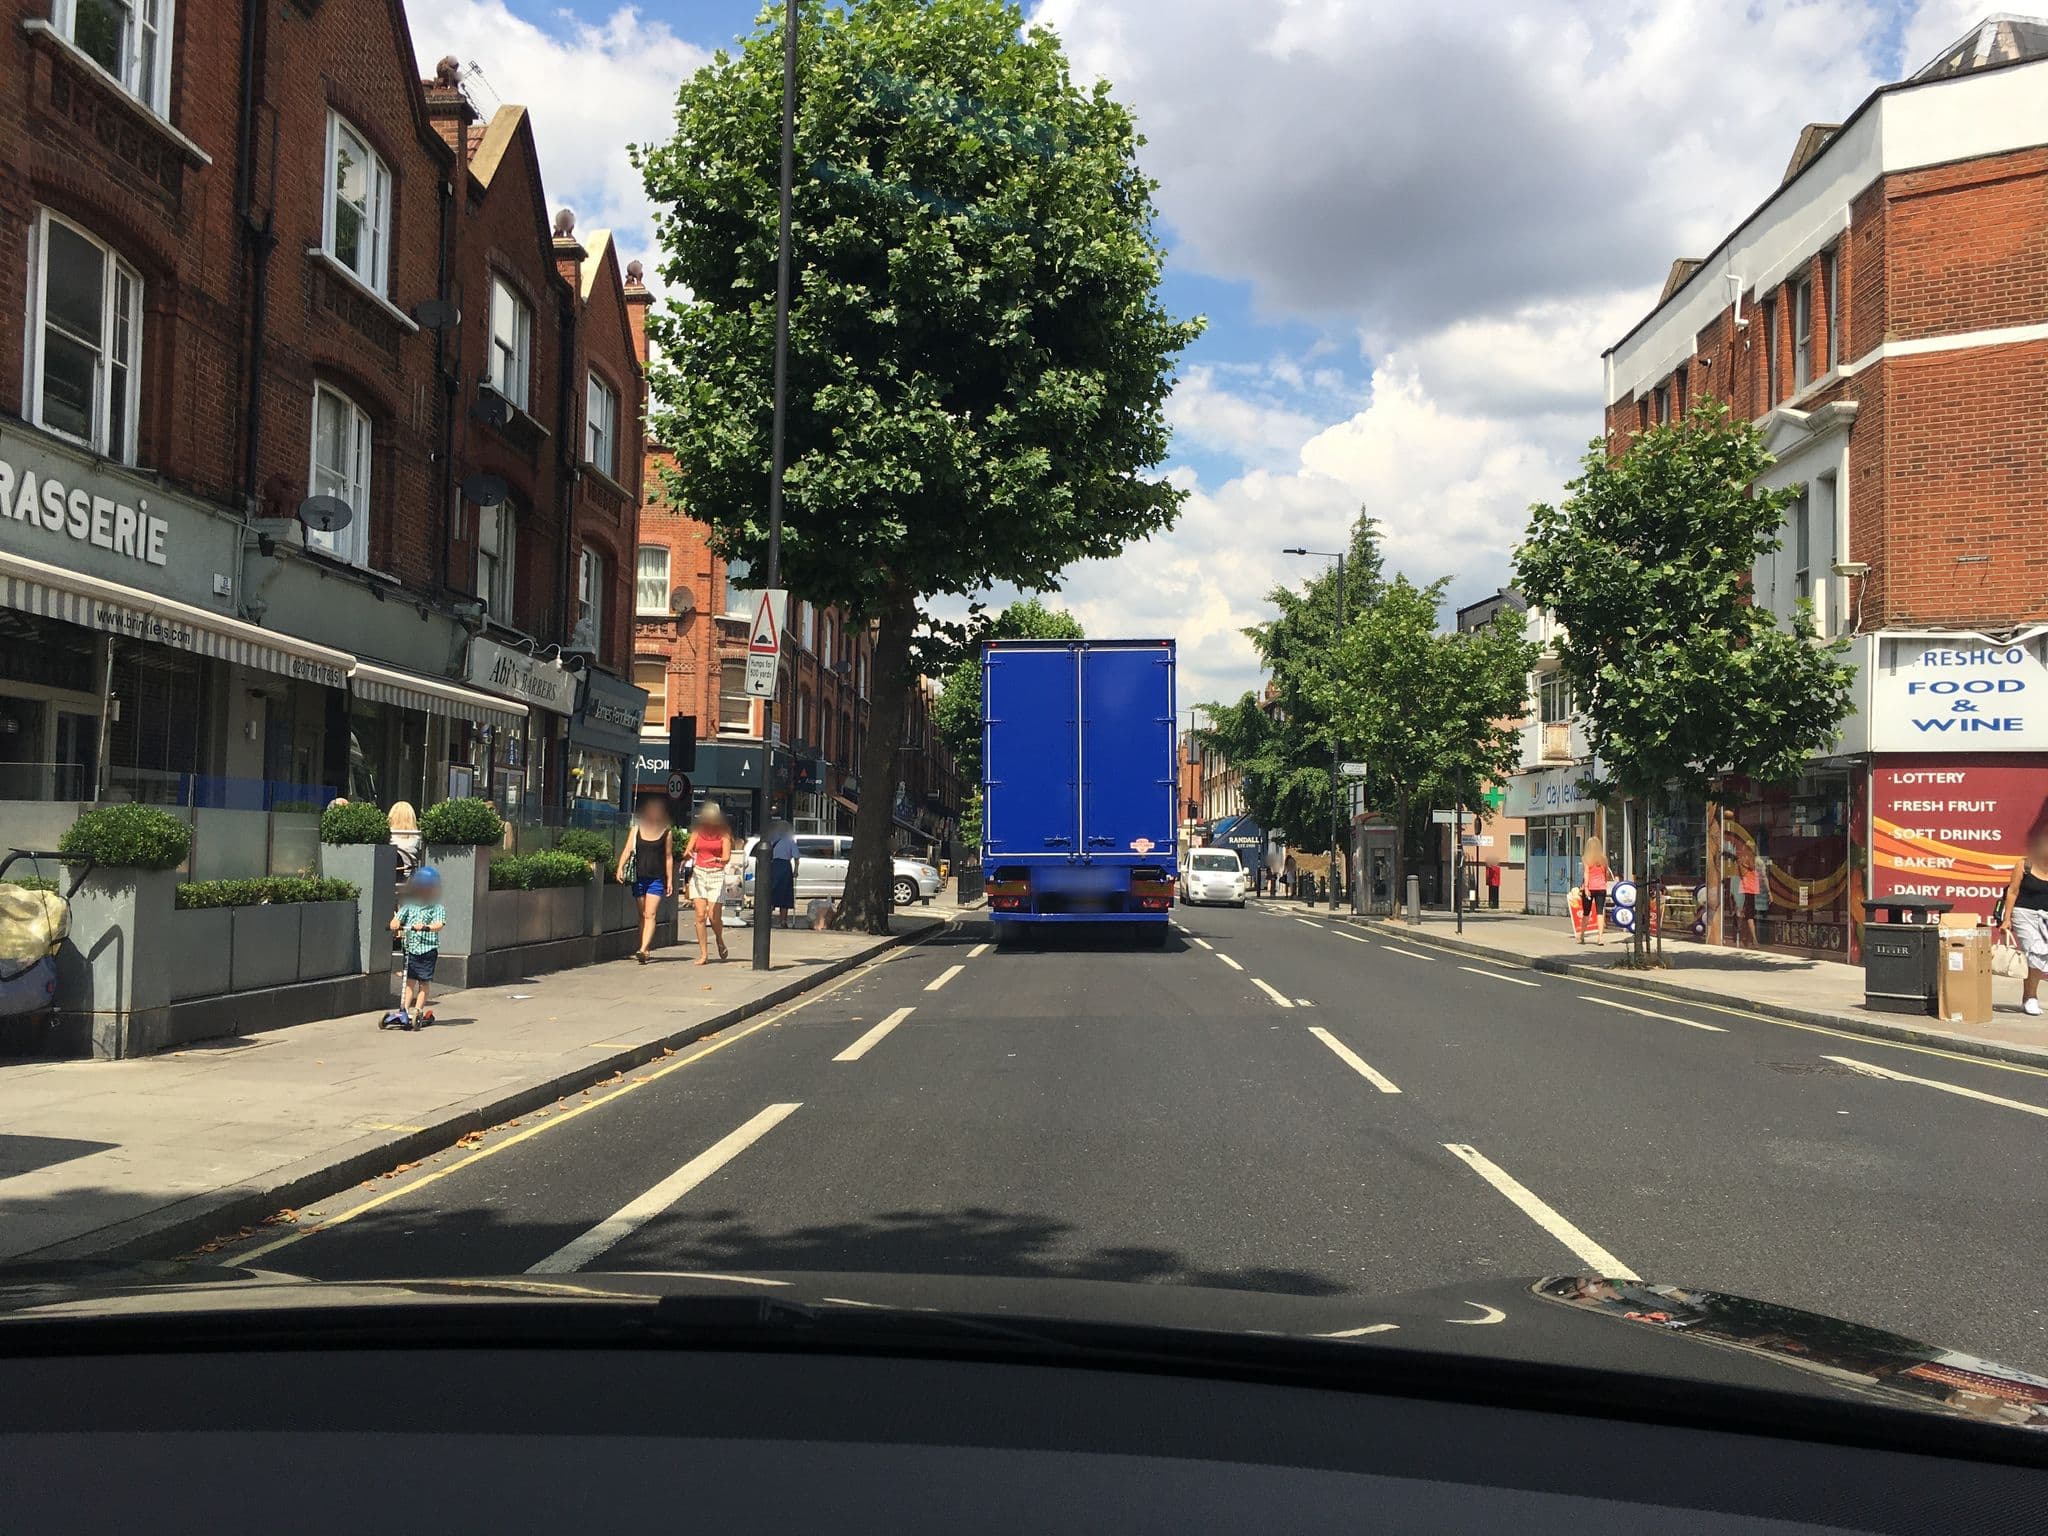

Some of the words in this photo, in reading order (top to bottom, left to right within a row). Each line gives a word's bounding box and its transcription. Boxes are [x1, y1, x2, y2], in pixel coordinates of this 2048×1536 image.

[1917, 648, 2023, 666] RESHCO
[489, 655, 519, 688] Abi's
[520, 672, 557, 701] BARBERS
[1908, 679, 2025, 695] FOOD
[1951, 699, 1979, 712] &
[1912, 718, 2024, 732] WINE
[1893, 773, 1965, 784] LOTTERY
[670, 781, 682, 793] 30
[1893, 801, 1944, 812] FRESH
[1948, 801, 1997, 812] FRUIT
[1893, 829, 1936, 840] SOFT
[1940, 829, 2002, 841] DRINKS
[1893, 857, 1956, 869] BAKERY
[1894, 885, 1941, 897] DAIRY
